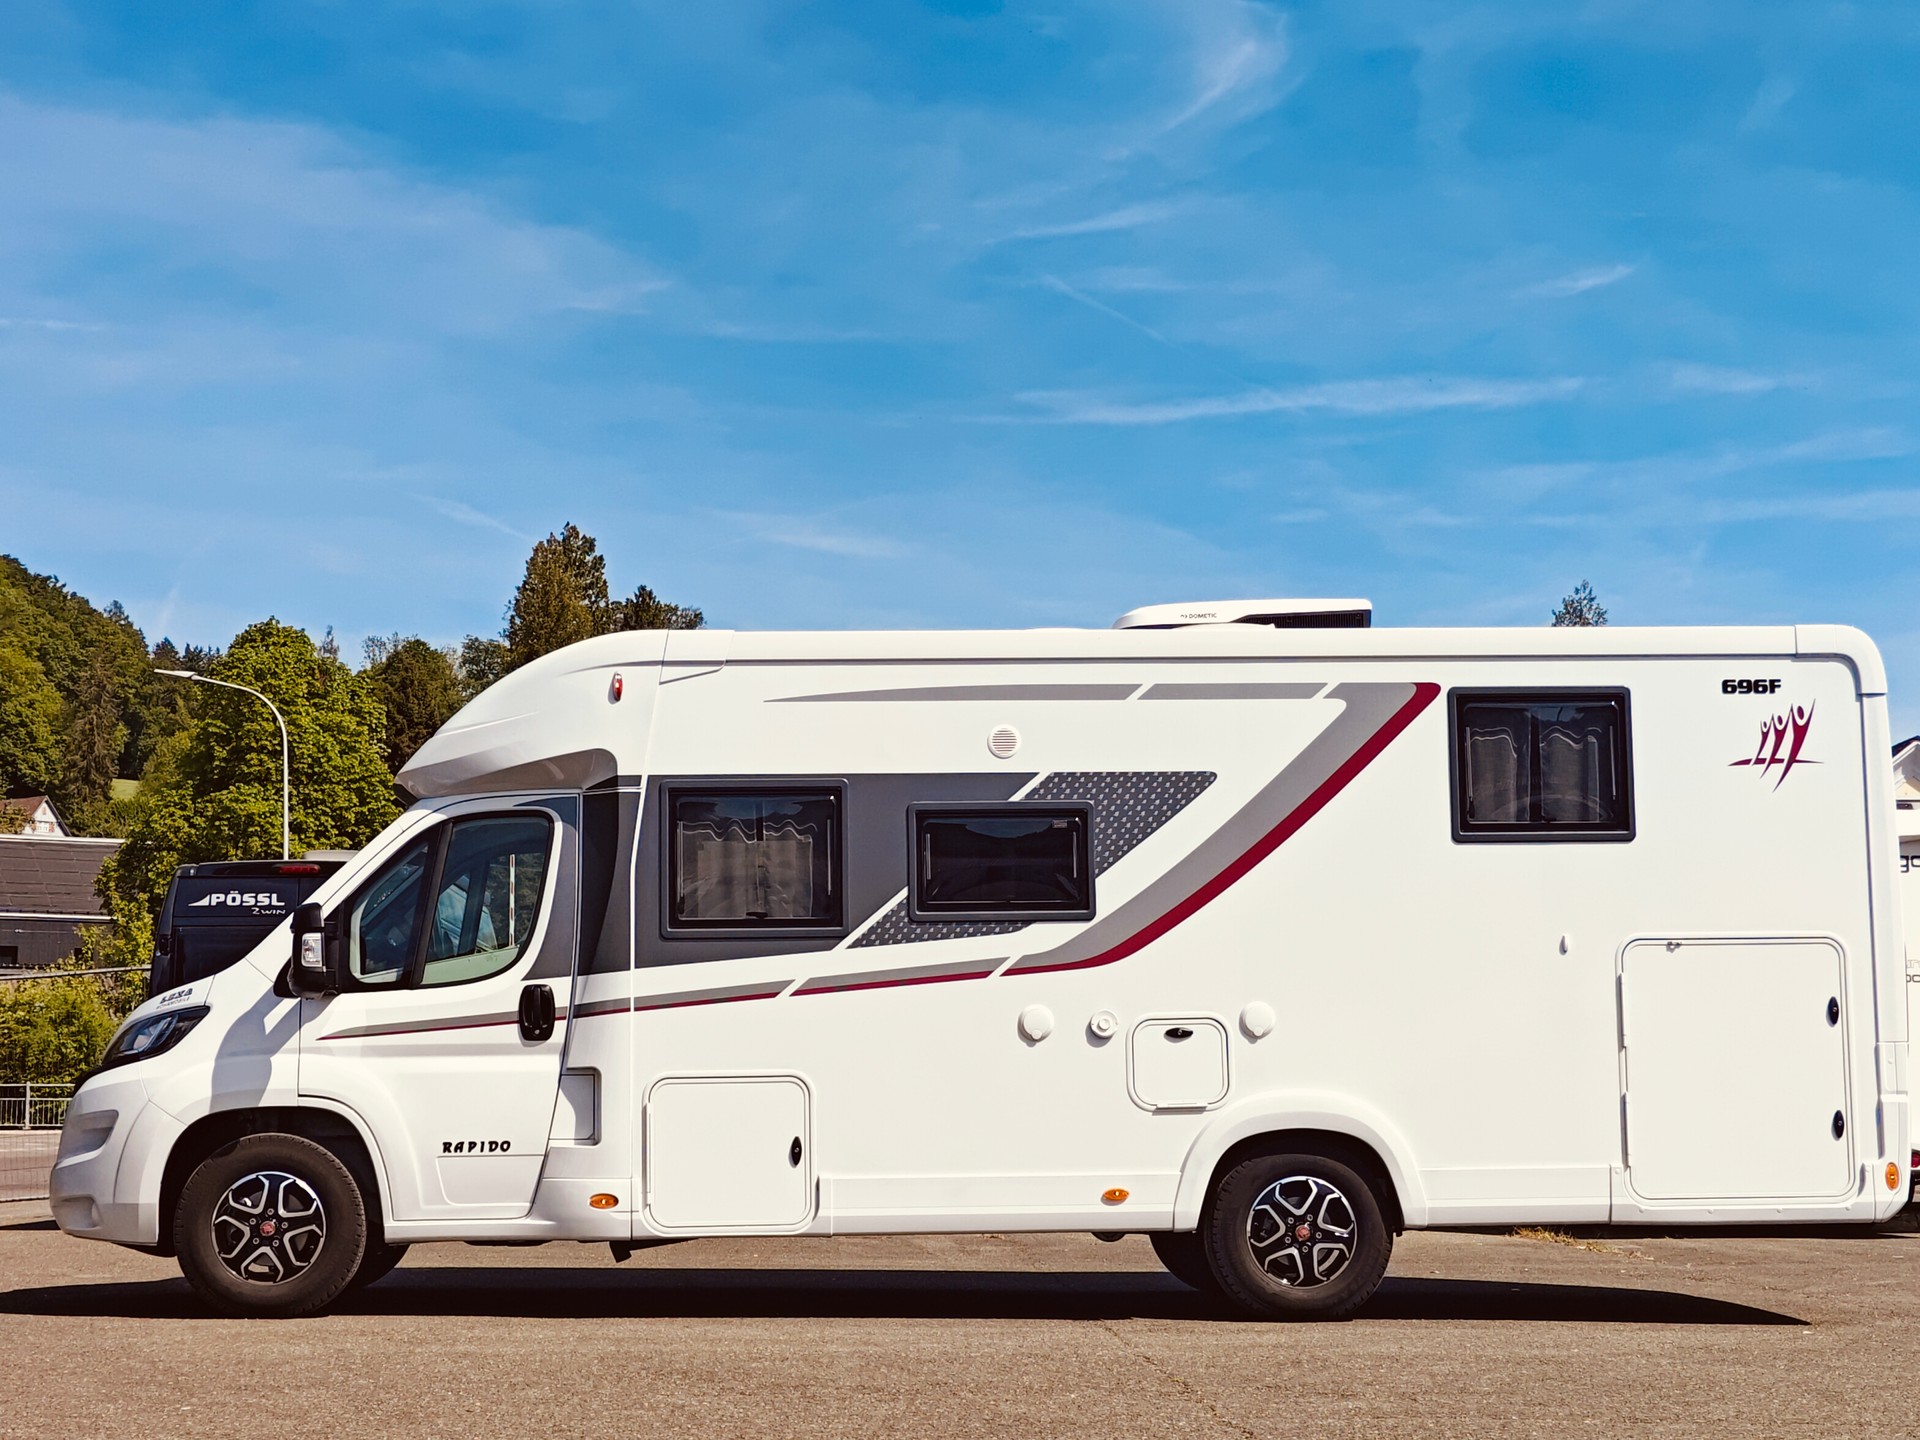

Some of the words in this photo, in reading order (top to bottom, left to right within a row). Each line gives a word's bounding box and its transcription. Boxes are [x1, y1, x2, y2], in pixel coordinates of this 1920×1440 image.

[1721, 679, 1782, 694] 696F
[210, 891, 286, 906] PÖSSL
[442, 1140, 511, 1153] RAPIDO
